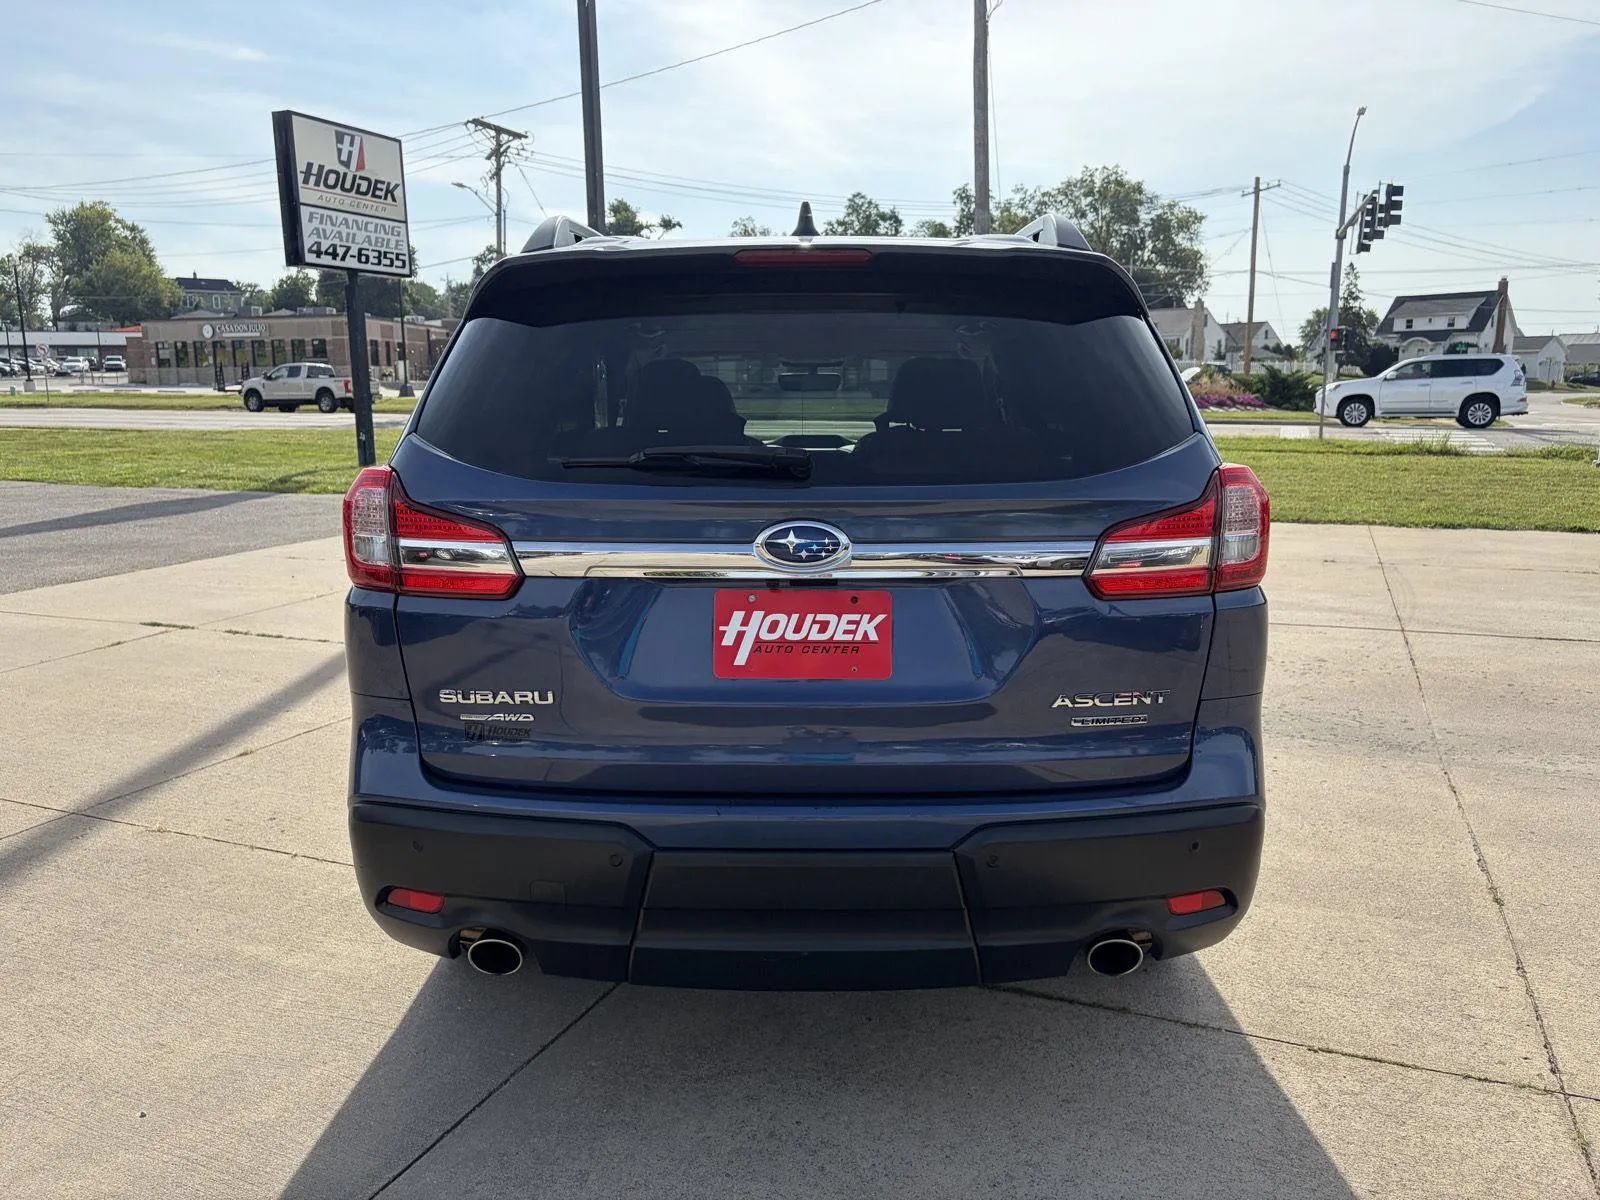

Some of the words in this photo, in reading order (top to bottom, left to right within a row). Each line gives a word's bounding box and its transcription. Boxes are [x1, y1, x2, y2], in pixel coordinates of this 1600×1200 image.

[300, 162, 400, 203] HOUDEK
[318, 195, 345, 206] AUTO
[349, 200, 387, 213] CENTER
[307, 211, 402, 237] FINANCING
[308, 226, 404, 251] AVAILABLE
[307, 241, 406, 269] 447-6355
[216, 324, 234, 333] CASA
[249, 323, 266, 332] JULIO
[719, 611, 887, 665] HOUDEK
[753, 645, 795, 654] AUTO
[802, 645, 860, 654] CENTER
[439, 689, 554, 705] SUBARU
[1051, 689, 1170, 708] ASCENT
[487, 713, 535, 721] AWD
[1080, 716, 1142, 725] LIMITED
